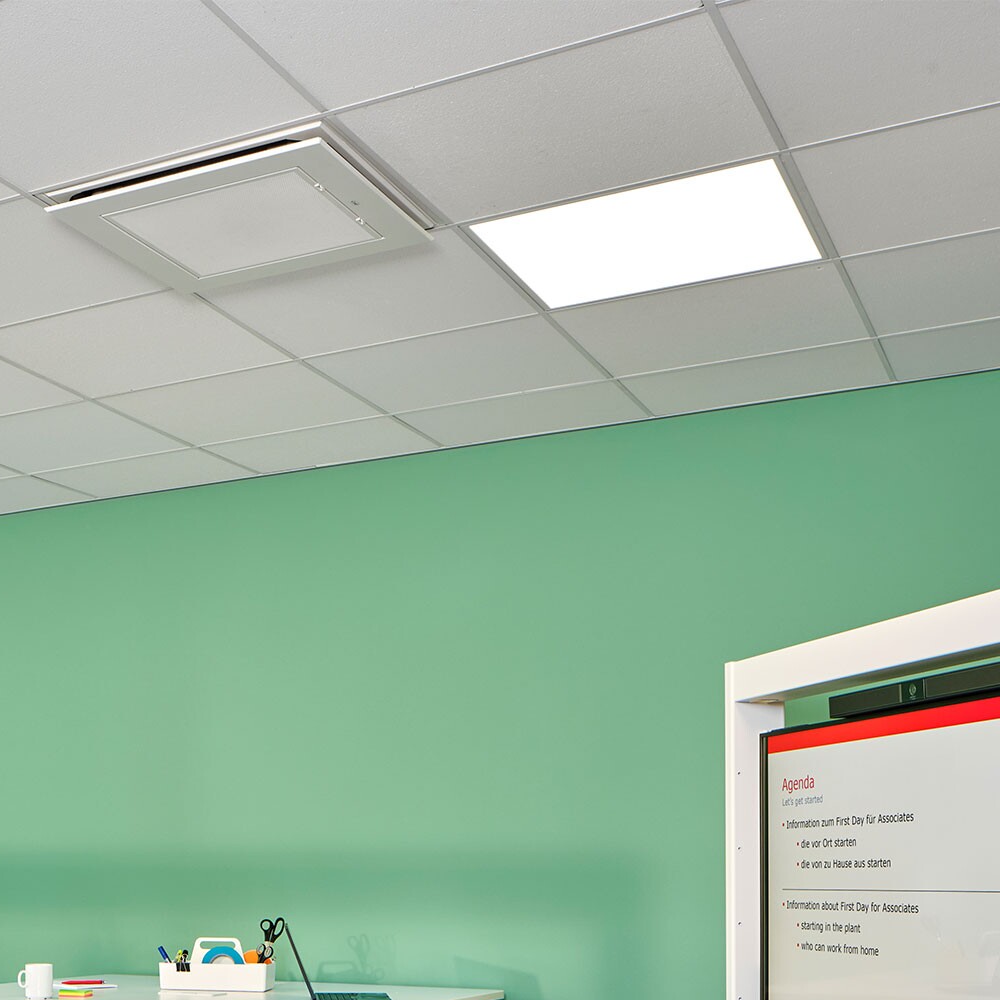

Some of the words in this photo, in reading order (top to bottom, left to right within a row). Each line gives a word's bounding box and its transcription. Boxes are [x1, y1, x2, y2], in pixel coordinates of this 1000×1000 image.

[782, 775, 815, 793] Agenda
[782, 797, 794, 806] Let's
[795, 797, 804, 807] get
[804, 795, 823, 804] started
[786, 819, 820, 829] Information
[821, 819, 834, 827] zum
[836, 817, 850, 826] First
[852, 816, 864, 827] Day
[866, 814, 876, 824] für
[878, 813, 914, 823] Associates
[801, 839, 810, 848] die
[811, 840, 821, 848] vor
[822, 838, 832, 847] Ort
[834, 838, 857, 847] starten
[801, 860, 810, 868] die
[833, 859, 852, 868] Hause
[854, 860, 865, 868] aus
[867, 859, 891, 868] starten
[786, 900, 820, 910] Information
[821, 901, 839, 911] about
[840, 902, 854, 911] First
[856, 902, 869, 914] Day
[870, 902, 881, 912] for
[882, 903, 919, 914] Associates
[801, 922, 823, 933] starting
[825, 922, 831, 931] in
[832, 922, 842, 932] the
[844, 923, 861, 934] plant
[801, 941, 813, 951] who
[814, 943, 825, 952] can
[827, 944, 842, 953] work
[843, 944, 858, 954] from
[860, 945, 879, 956] home
